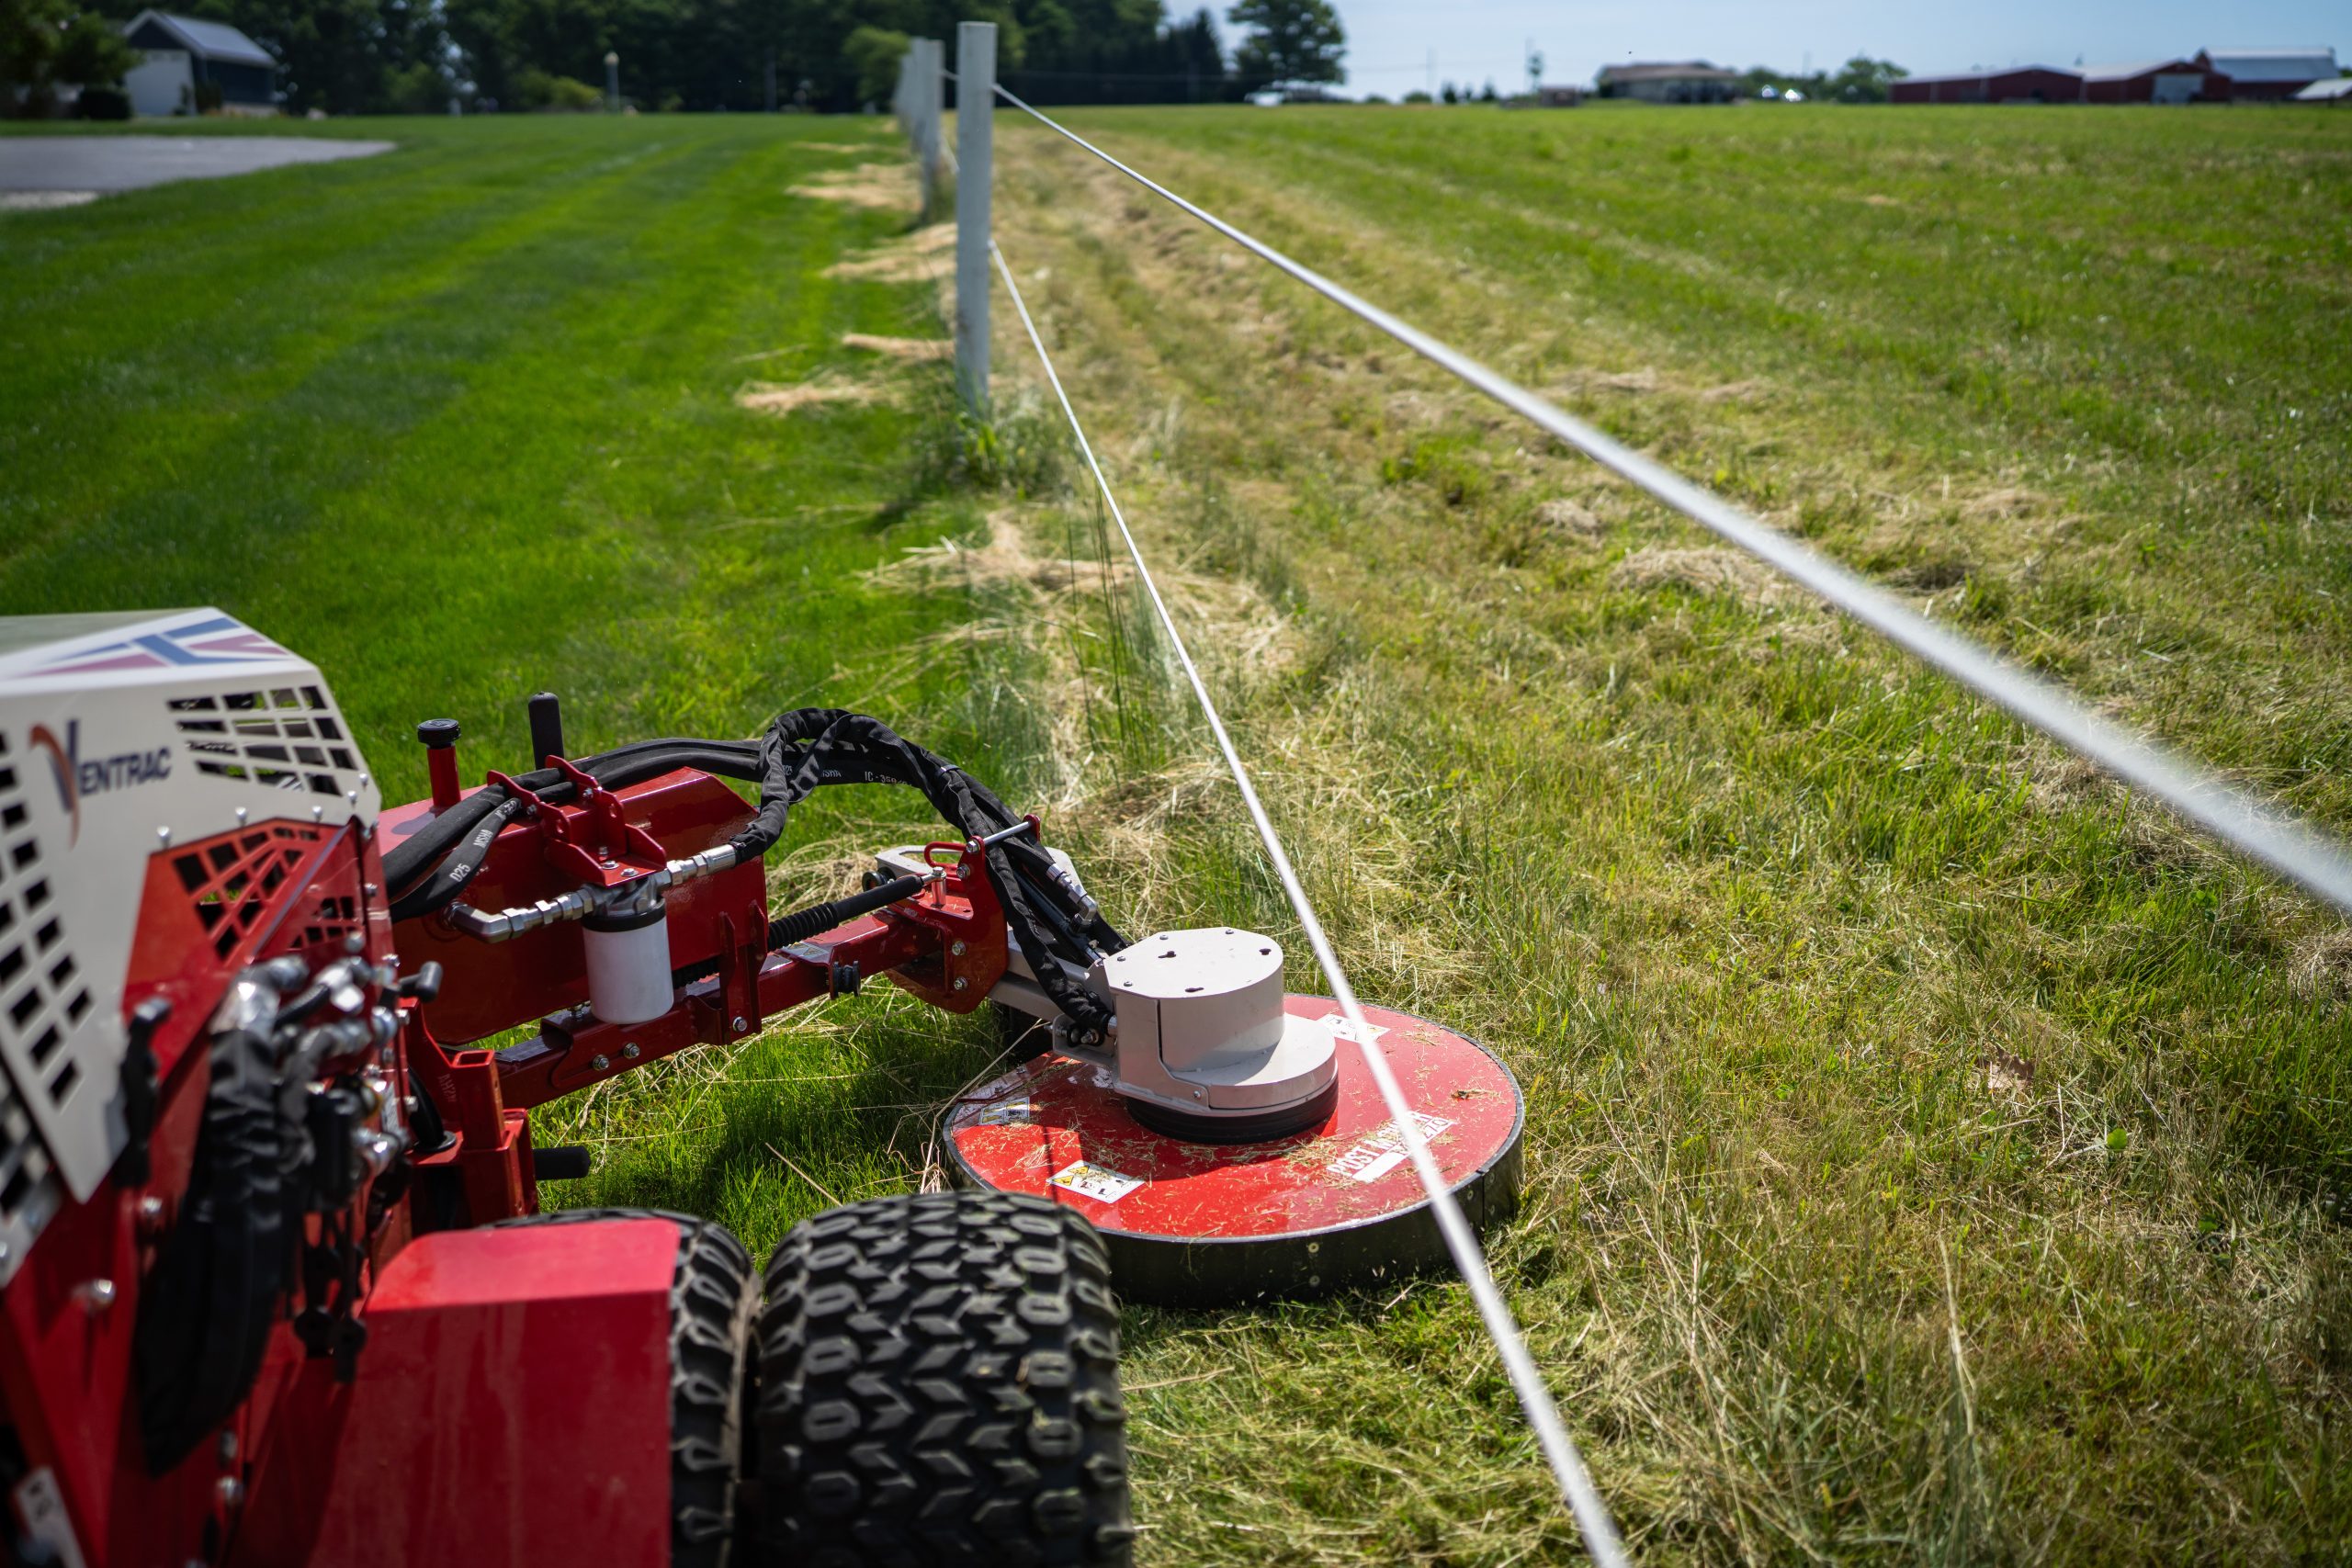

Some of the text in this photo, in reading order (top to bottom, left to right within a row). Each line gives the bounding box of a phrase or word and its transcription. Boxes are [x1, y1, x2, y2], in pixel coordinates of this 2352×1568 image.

[29, 719, 172, 845] VENTRAC
[449, 863, 470, 882] D25
[1326, 1145, 1381, 1177] POST
